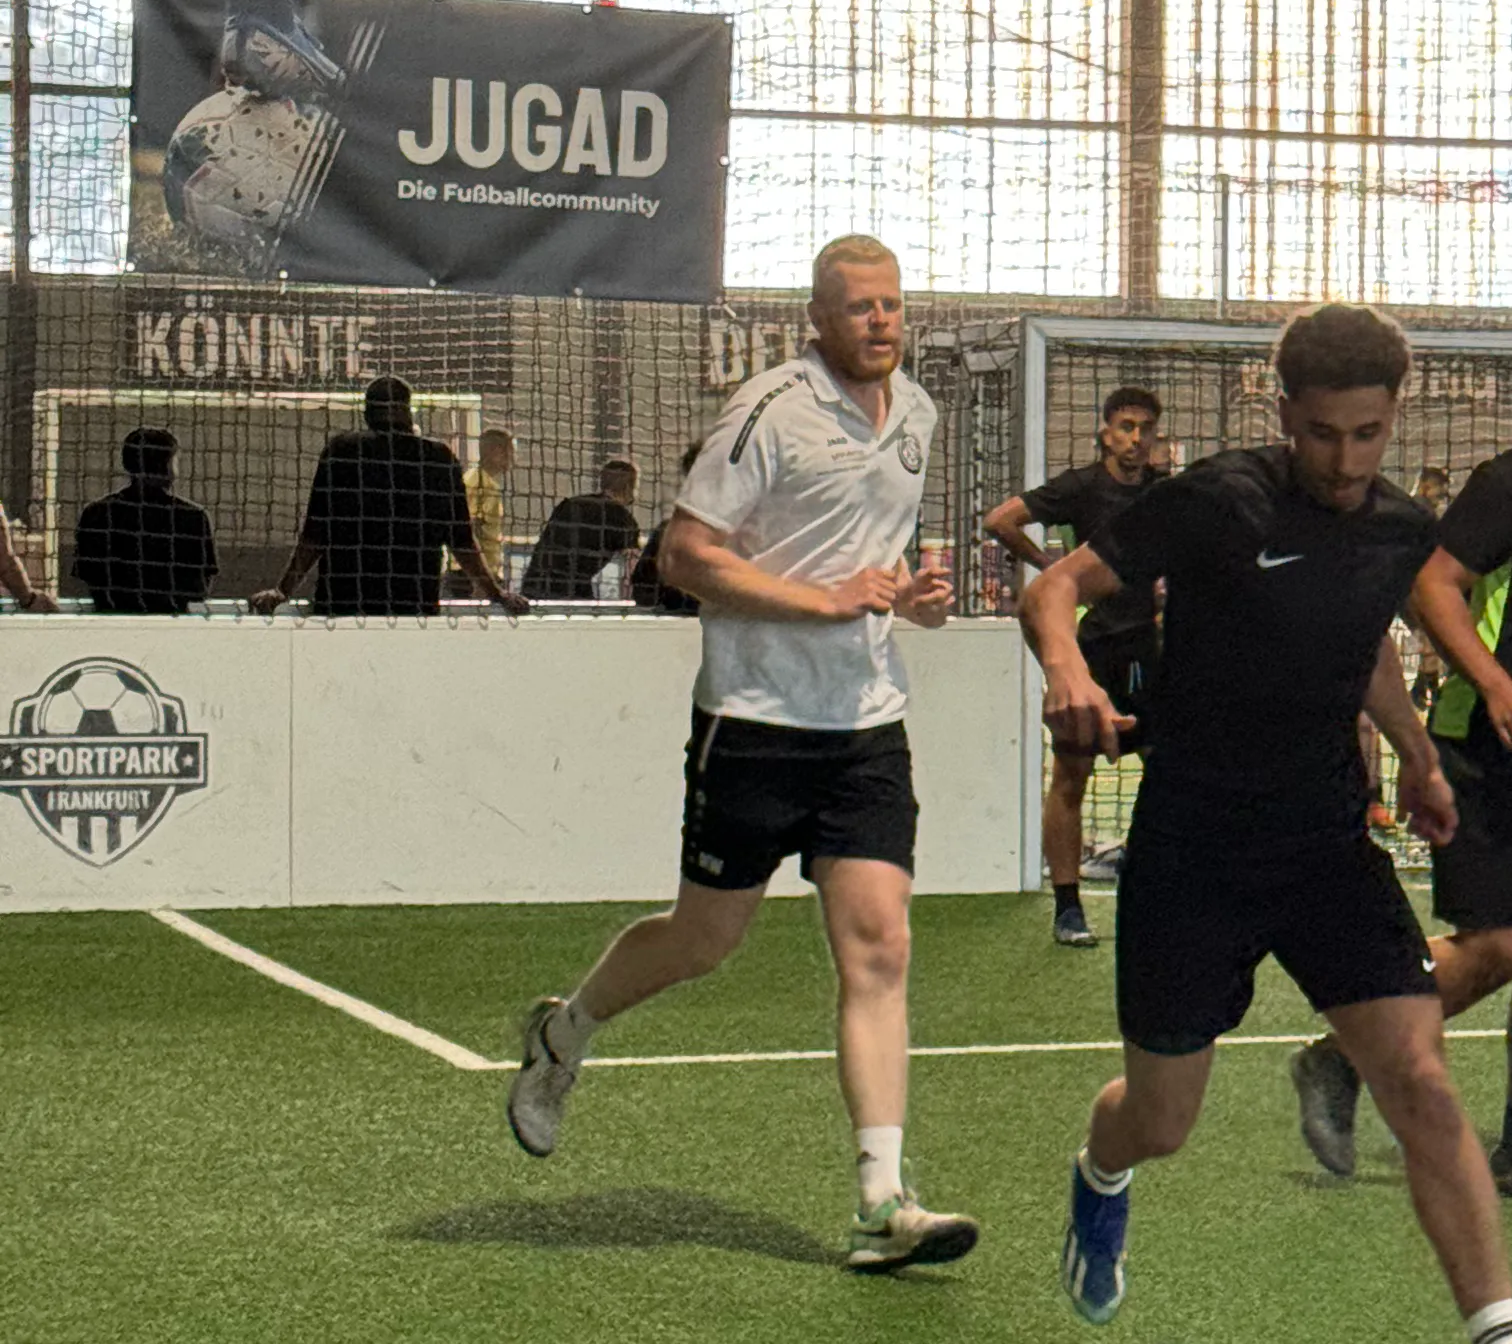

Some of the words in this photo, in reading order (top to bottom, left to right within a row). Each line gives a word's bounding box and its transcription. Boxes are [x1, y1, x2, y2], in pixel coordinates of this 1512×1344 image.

[398, 76, 669, 178] JUGAD
[397, 179, 438, 201] Die
[443, 183, 661, 218] Fußballcommunity
[137, 294, 378, 378] KÖNNTE
[21, 746, 180, 776] SPORTPARK
